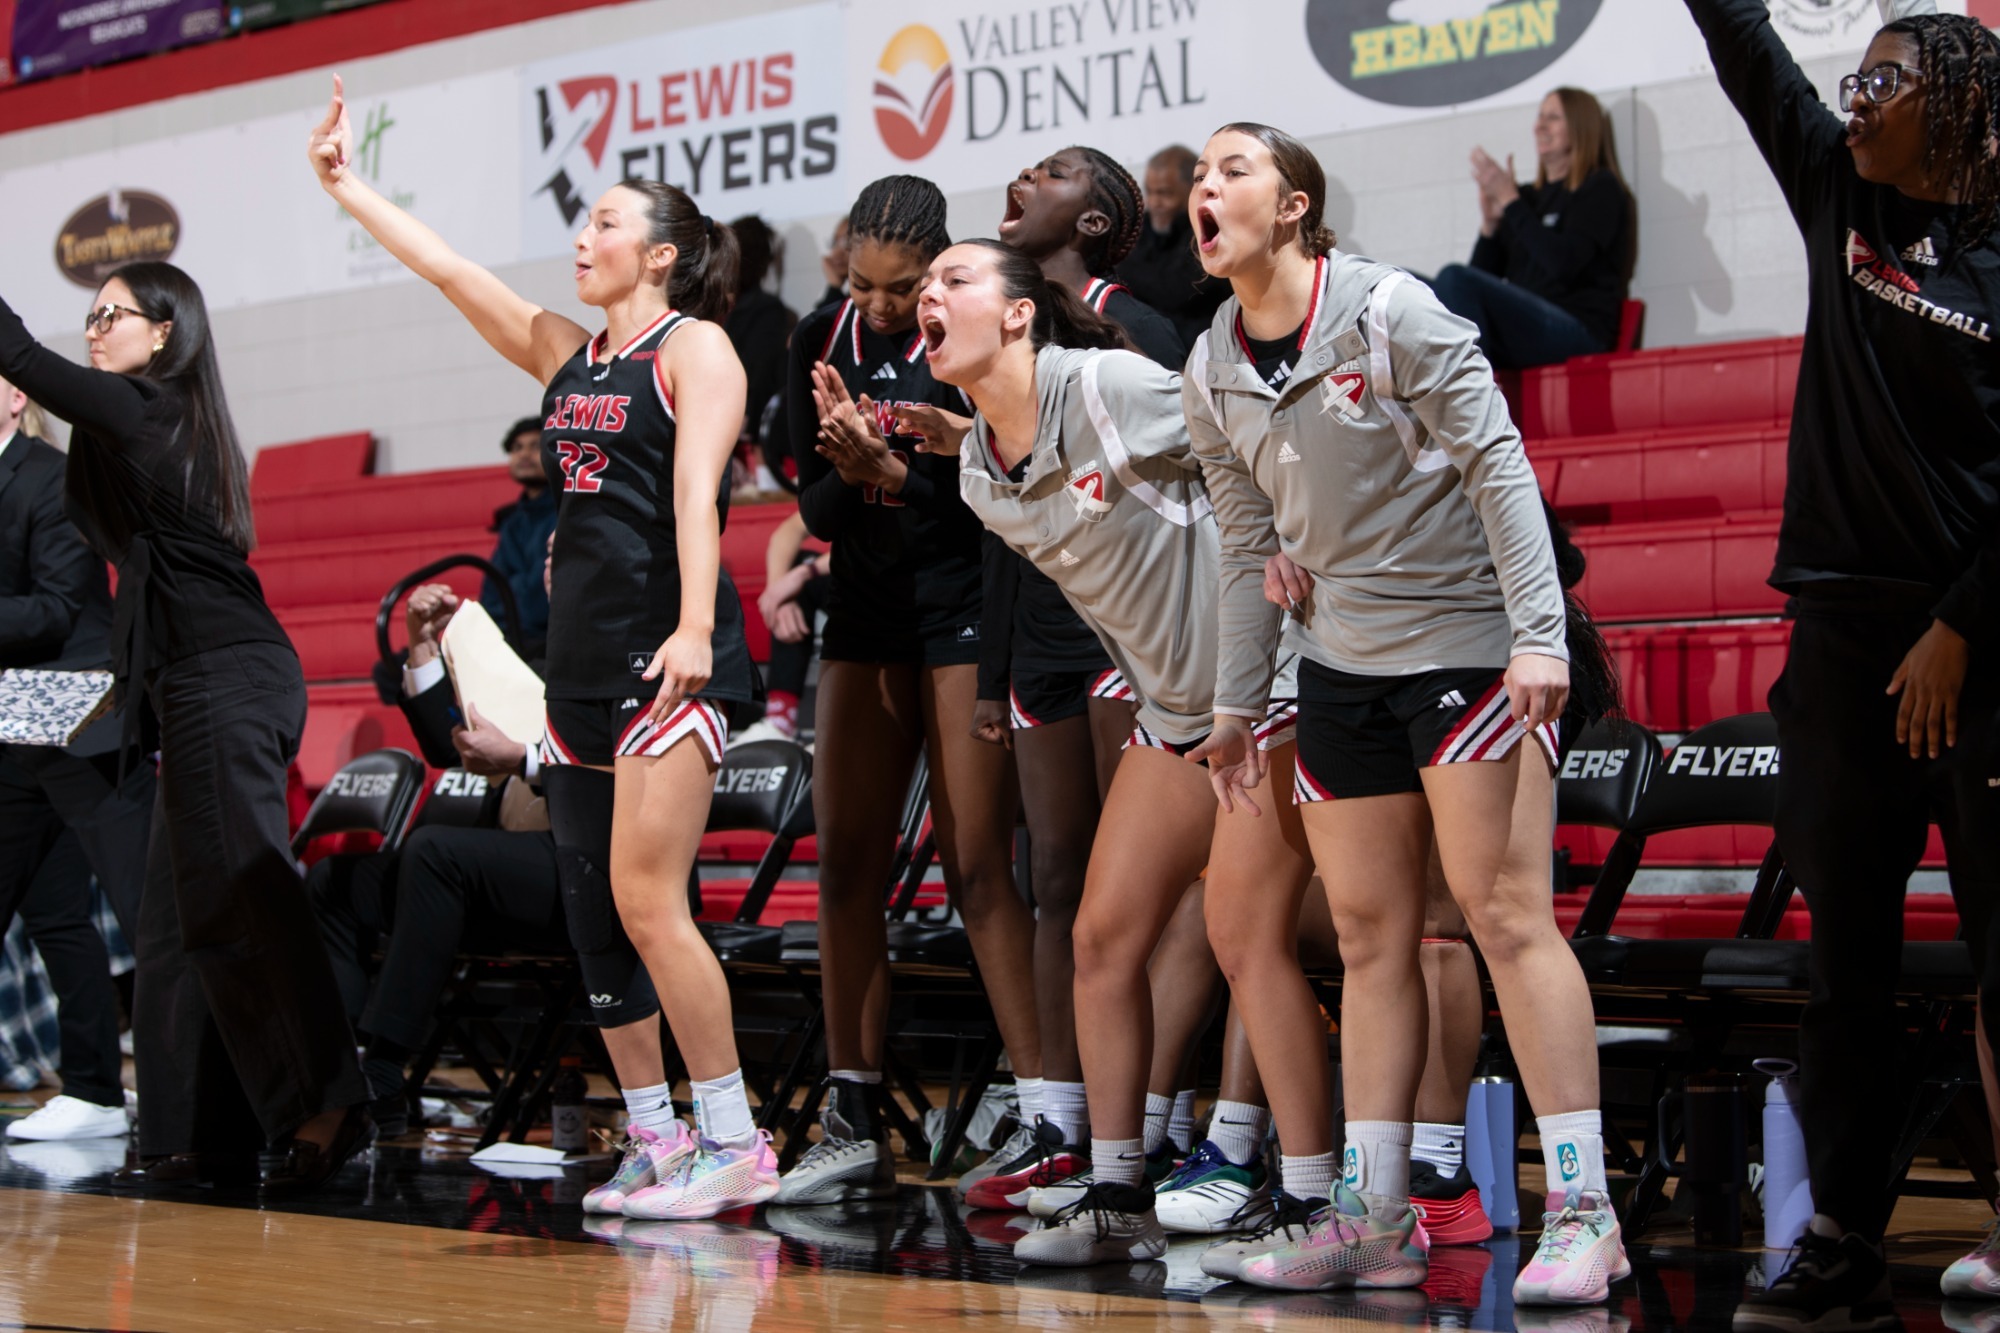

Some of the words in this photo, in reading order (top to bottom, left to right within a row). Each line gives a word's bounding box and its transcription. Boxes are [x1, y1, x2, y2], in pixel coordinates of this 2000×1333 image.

[957, 1, 1089, 62] VALLEY
[1102, 0, 1201, 36] VIEW
[1350, 0, 1561, 79] HEAVEN
[628, 51, 794, 134] LEWIS
[962, 37, 1206, 142] DENTAL
[619, 113, 838, 196] FLYERS
[1870, 259, 1921, 293] LEWIS
[1900, 252, 1939, 266] adidas
[1853, 267, 1992, 343] BASKETBALL
[544, 393, 632, 433] LEWIS
[556, 440, 610, 493] 22
[1277, 453, 1302, 464] adidas
[713, 765, 789, 794] LYERS
[1559, 749, 1630, 779] ERS
[325, 772, 399, 798] FLYERS
[434, 772, 489, 797] FLYE
